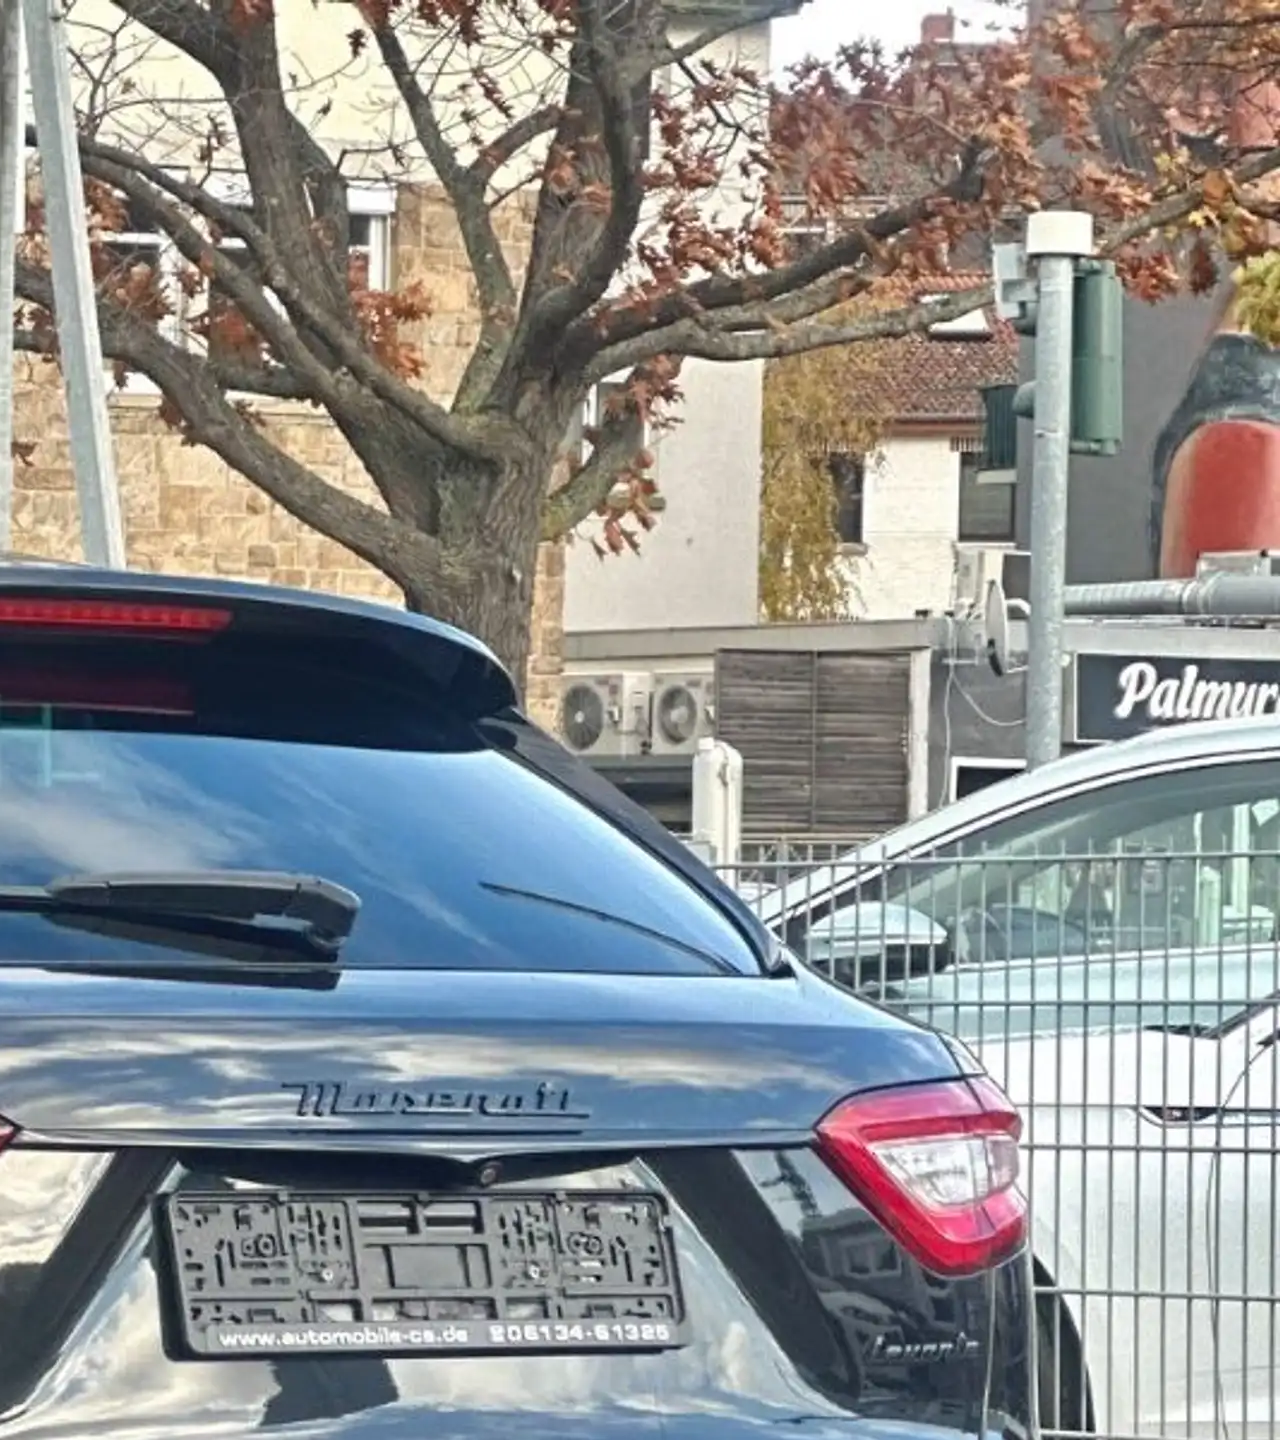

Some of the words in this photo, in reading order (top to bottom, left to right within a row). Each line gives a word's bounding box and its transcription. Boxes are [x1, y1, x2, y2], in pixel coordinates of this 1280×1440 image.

[1113, 661, 1280, 720] Palmur
[281, 1082, 590, 1118] Maserati
[218, 1325, 469, 1346] www.automobile-cs.de
